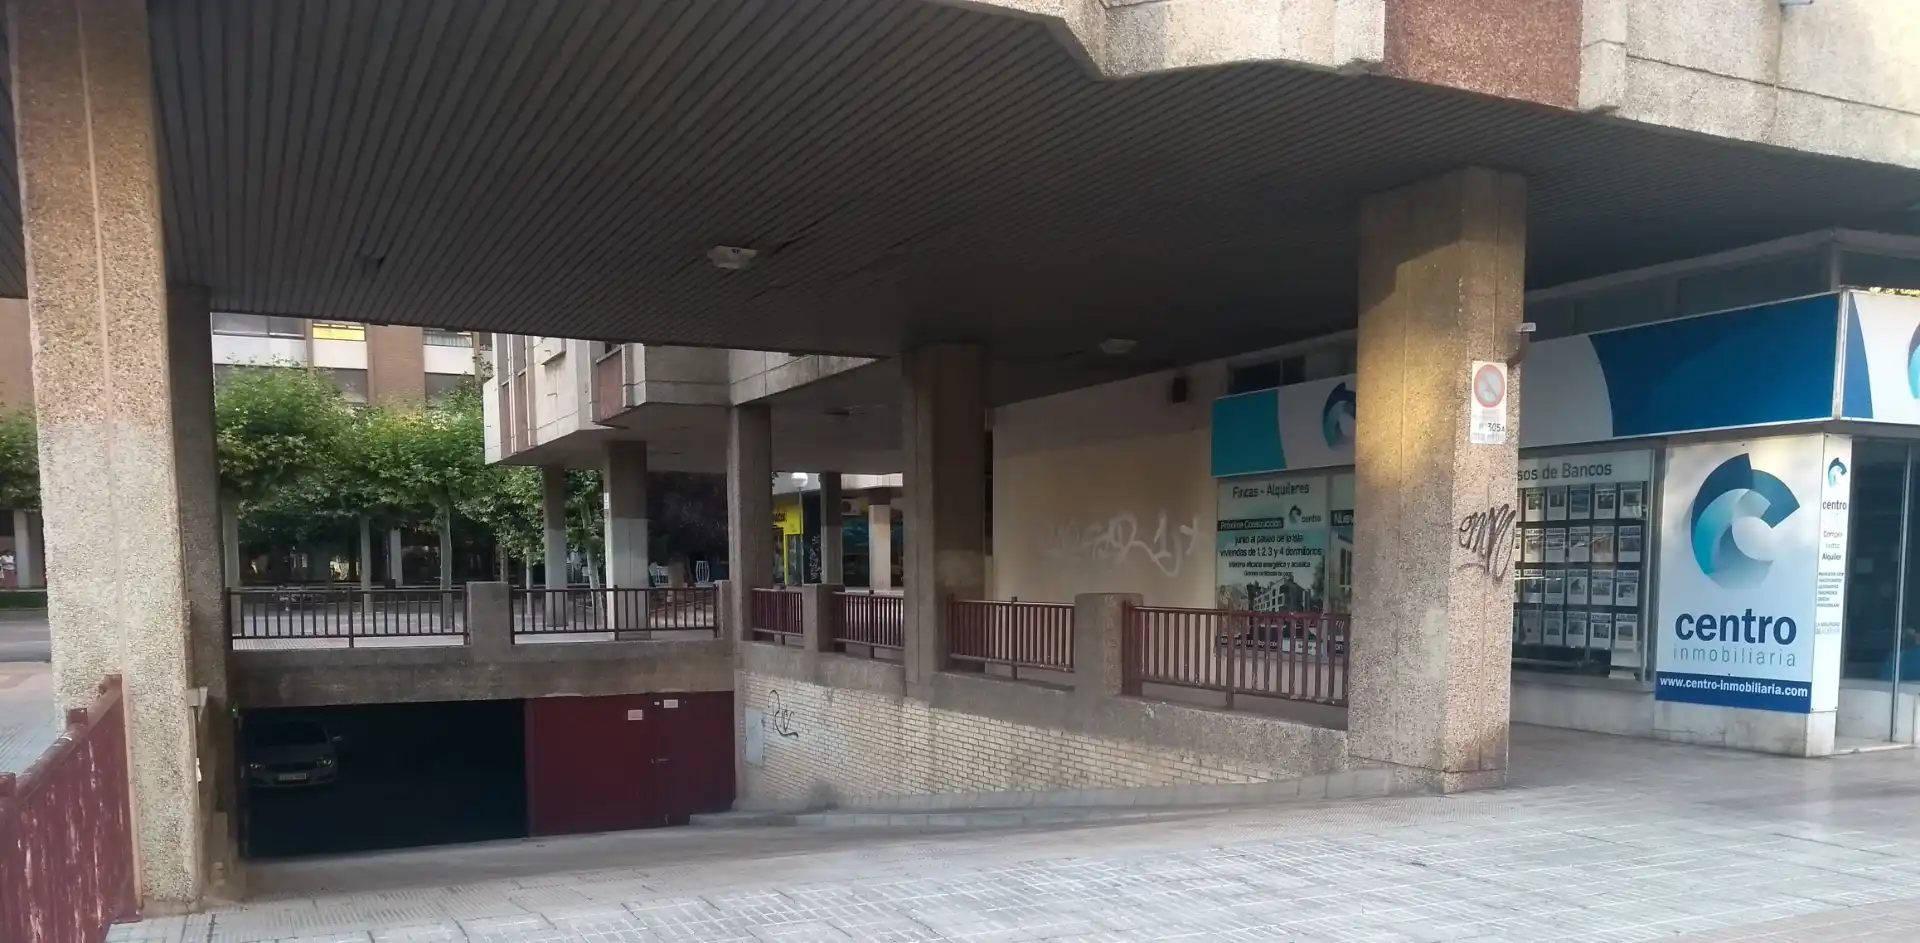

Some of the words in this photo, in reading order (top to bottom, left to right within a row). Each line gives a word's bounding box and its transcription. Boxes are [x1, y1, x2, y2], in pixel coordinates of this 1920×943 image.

[1541, 463, 1558, 480] de
[1561, 462, 1613, 478] Bancos
[1232, 486, 1259, 498] Fincas
[1266, 482, 1310, 498] Alquileres
[1822, 500, 1848, 511] centro
[1675, 608, 1797, 645] centro
[1673, 644, 1796, 667] inmobiliaria
[1659, 676, 1808, 698] www.centro-inmobiliaria.com
